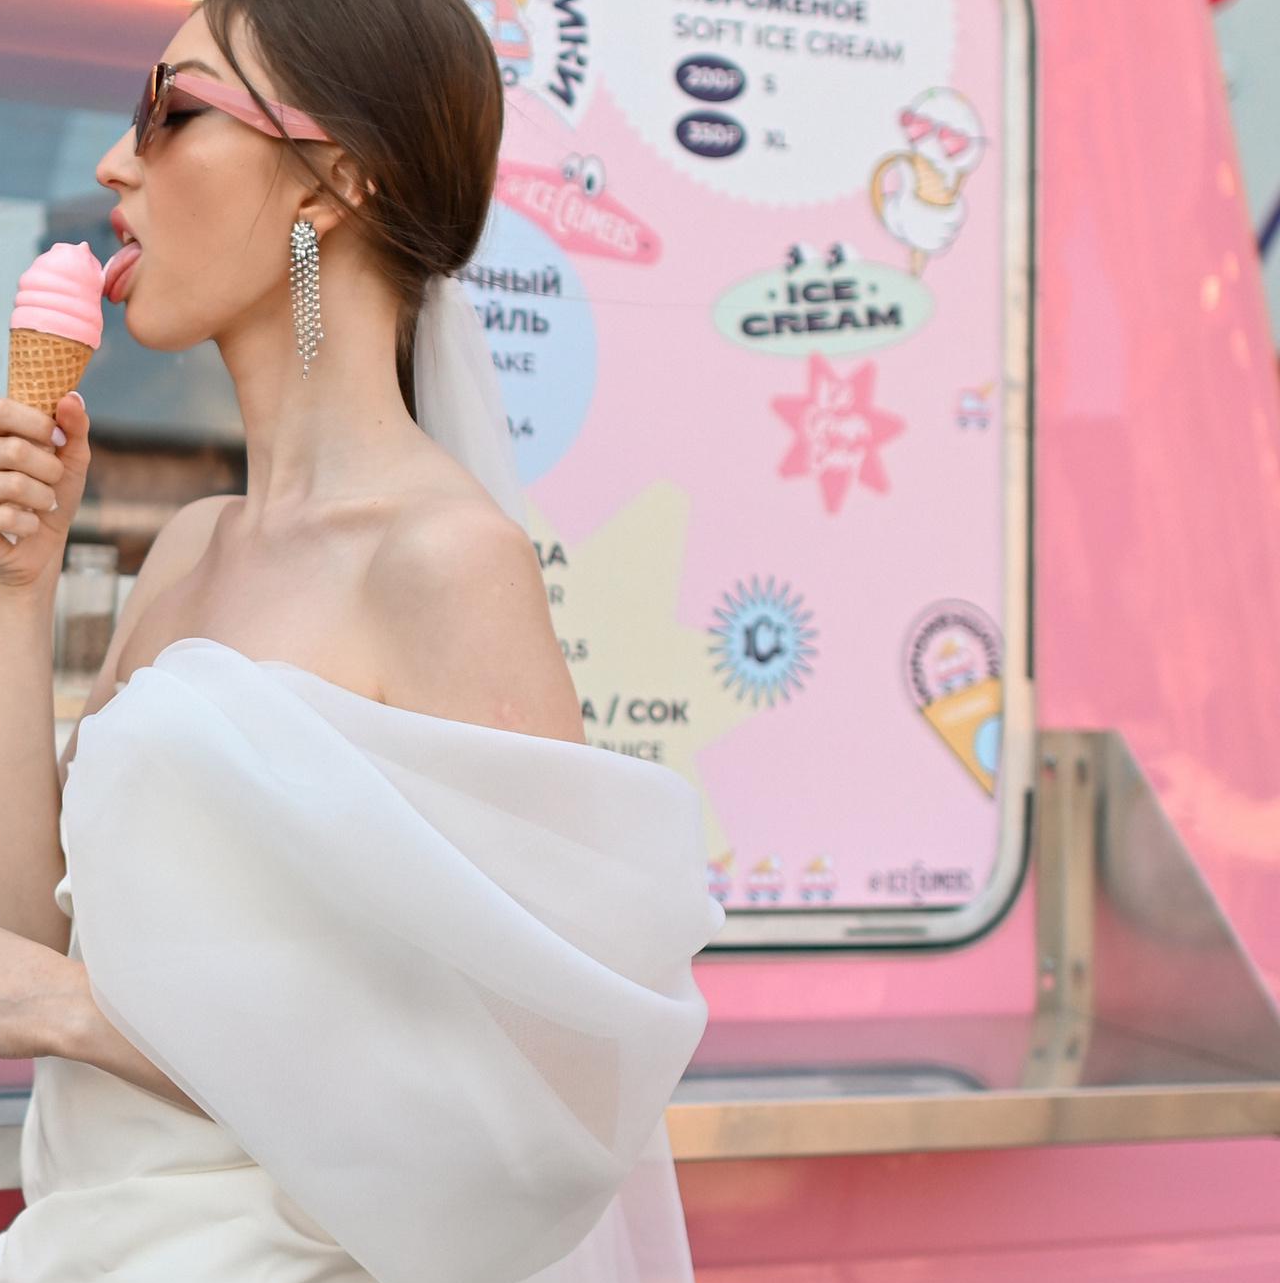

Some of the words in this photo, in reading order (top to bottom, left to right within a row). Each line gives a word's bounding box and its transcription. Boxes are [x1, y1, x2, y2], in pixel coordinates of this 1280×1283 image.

[673, 13, 746, 45] SOFT
[754, 23, 797, 52] ICE
[805, 29, 906, 64] CREAM
[460, 263, 562, 297] ЧНЫЙ
[786, 280, 859, 306] ICE
[740, 305, 903, 338] CREAM
[492, 350, 535, 375] AKE
[627, 697, 689, 725] СОК
